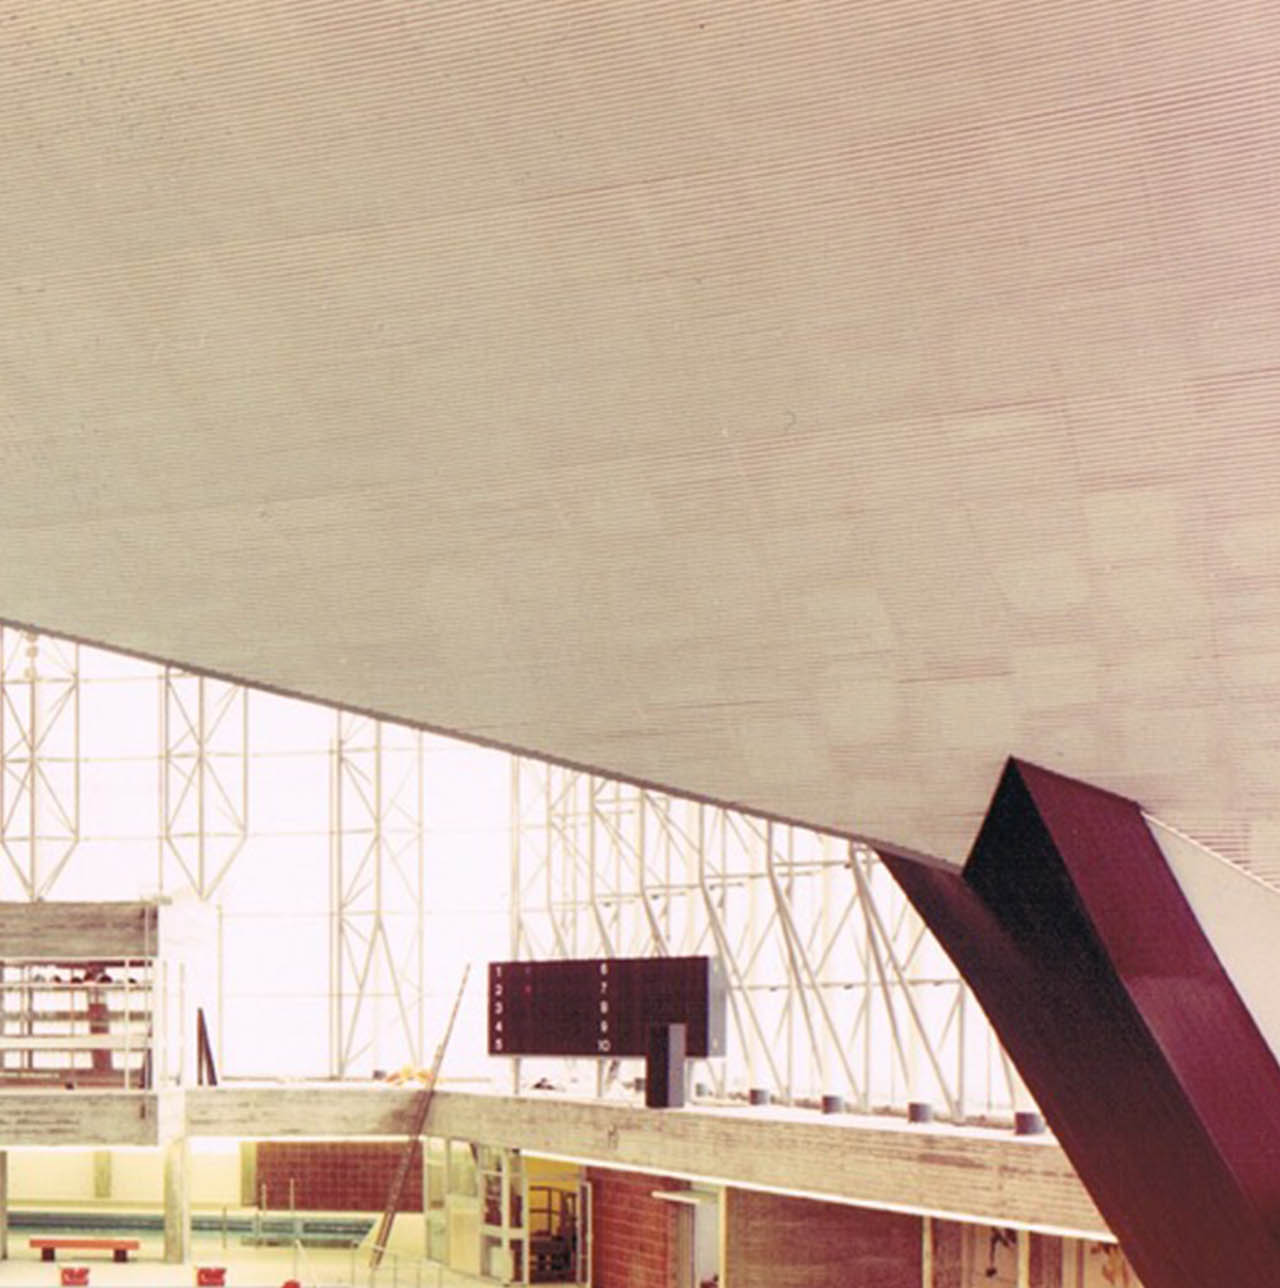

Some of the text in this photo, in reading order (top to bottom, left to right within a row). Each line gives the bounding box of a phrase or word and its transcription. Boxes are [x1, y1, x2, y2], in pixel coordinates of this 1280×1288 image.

[494, 983, 504, 996] 2
[600, 981, 608, 994] 7
[494, 1001, 504, 1015] 3
[494, 1020, 503, 1032] 4
[597, 1039, 611, 1052] 10
